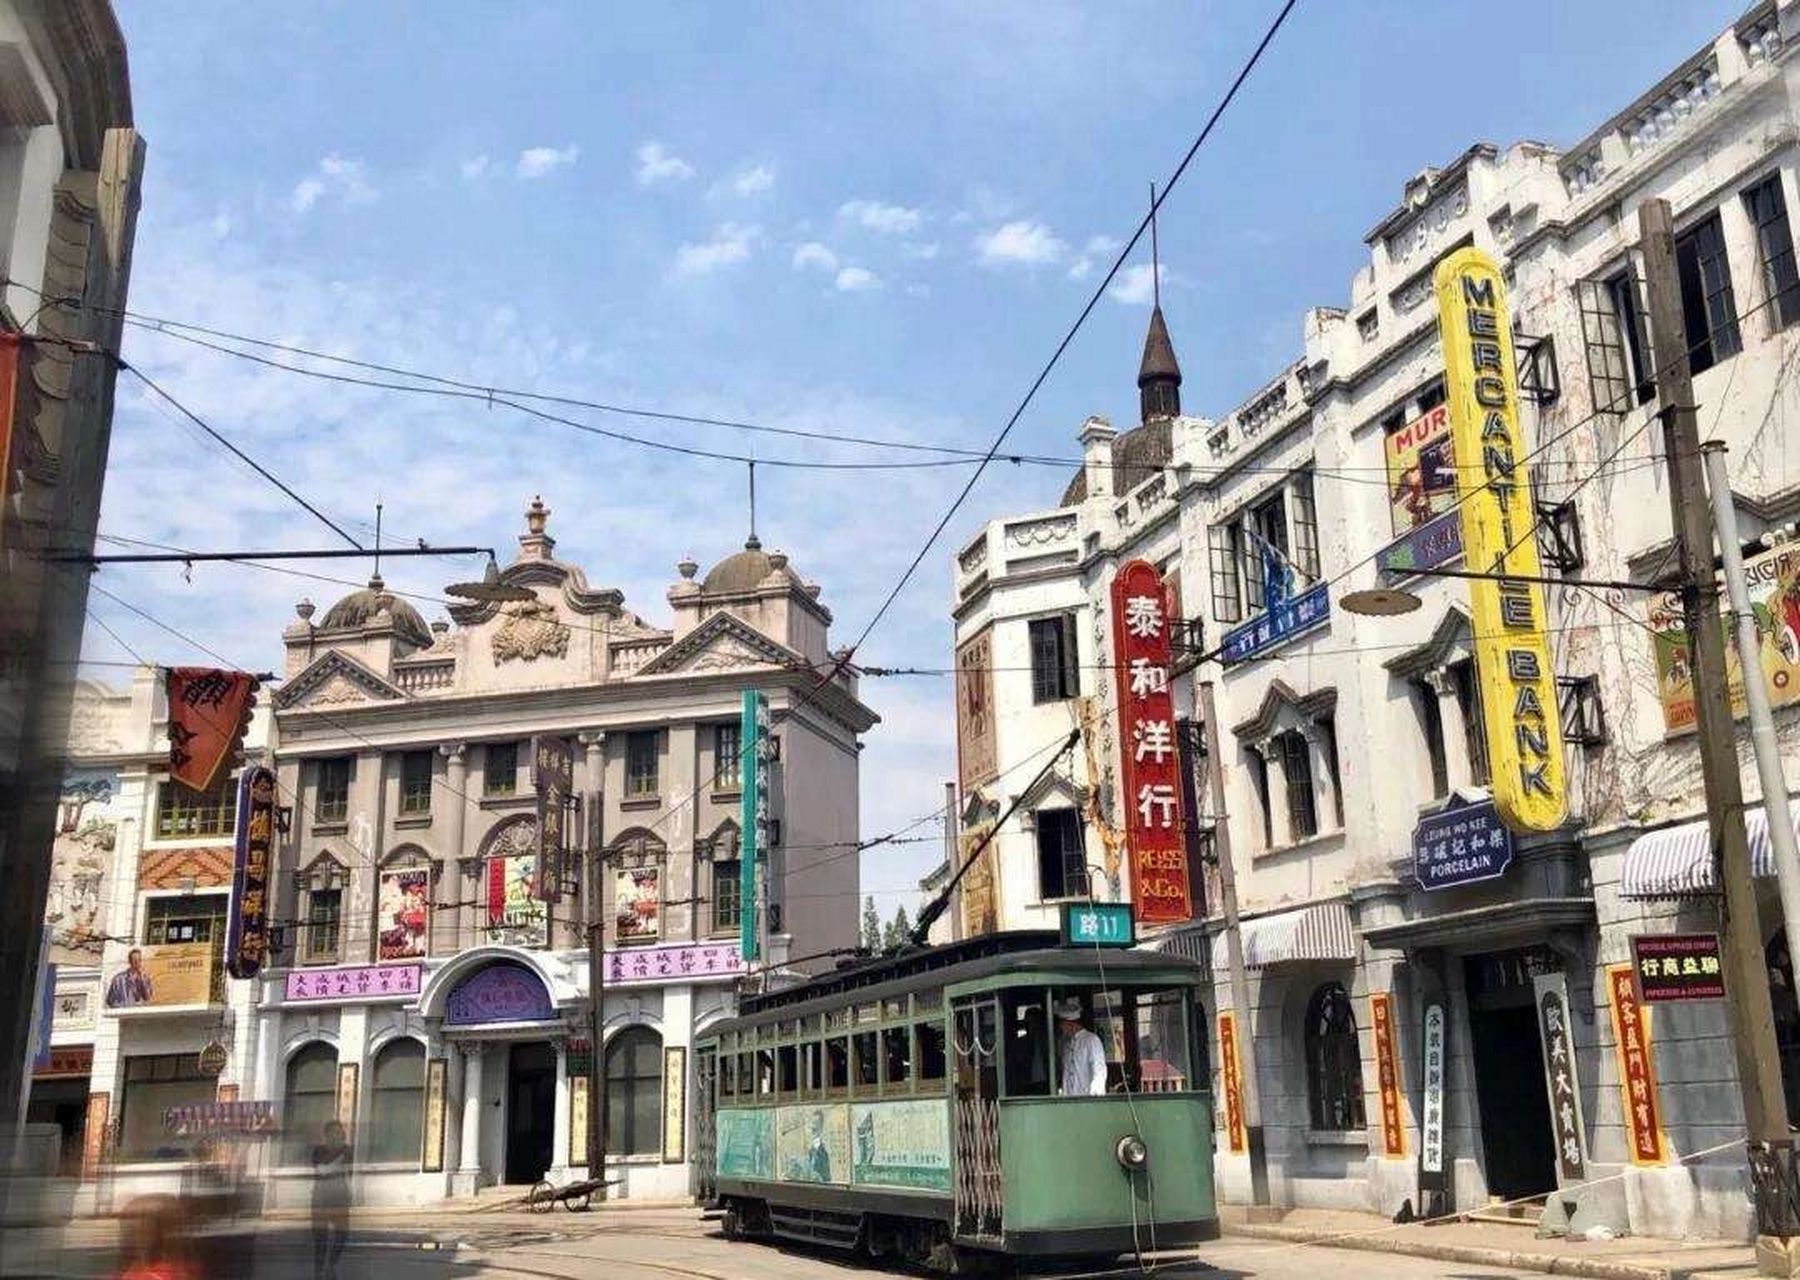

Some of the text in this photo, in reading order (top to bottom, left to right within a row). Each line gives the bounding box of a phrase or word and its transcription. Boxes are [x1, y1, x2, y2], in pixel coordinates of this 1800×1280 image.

[1462, 276, 1553, 797] MERCANTILE BANK
[1125, 595, 1179, 829] 泰和洋行
[1430, 855, 1492, 879] PORCELAIN
